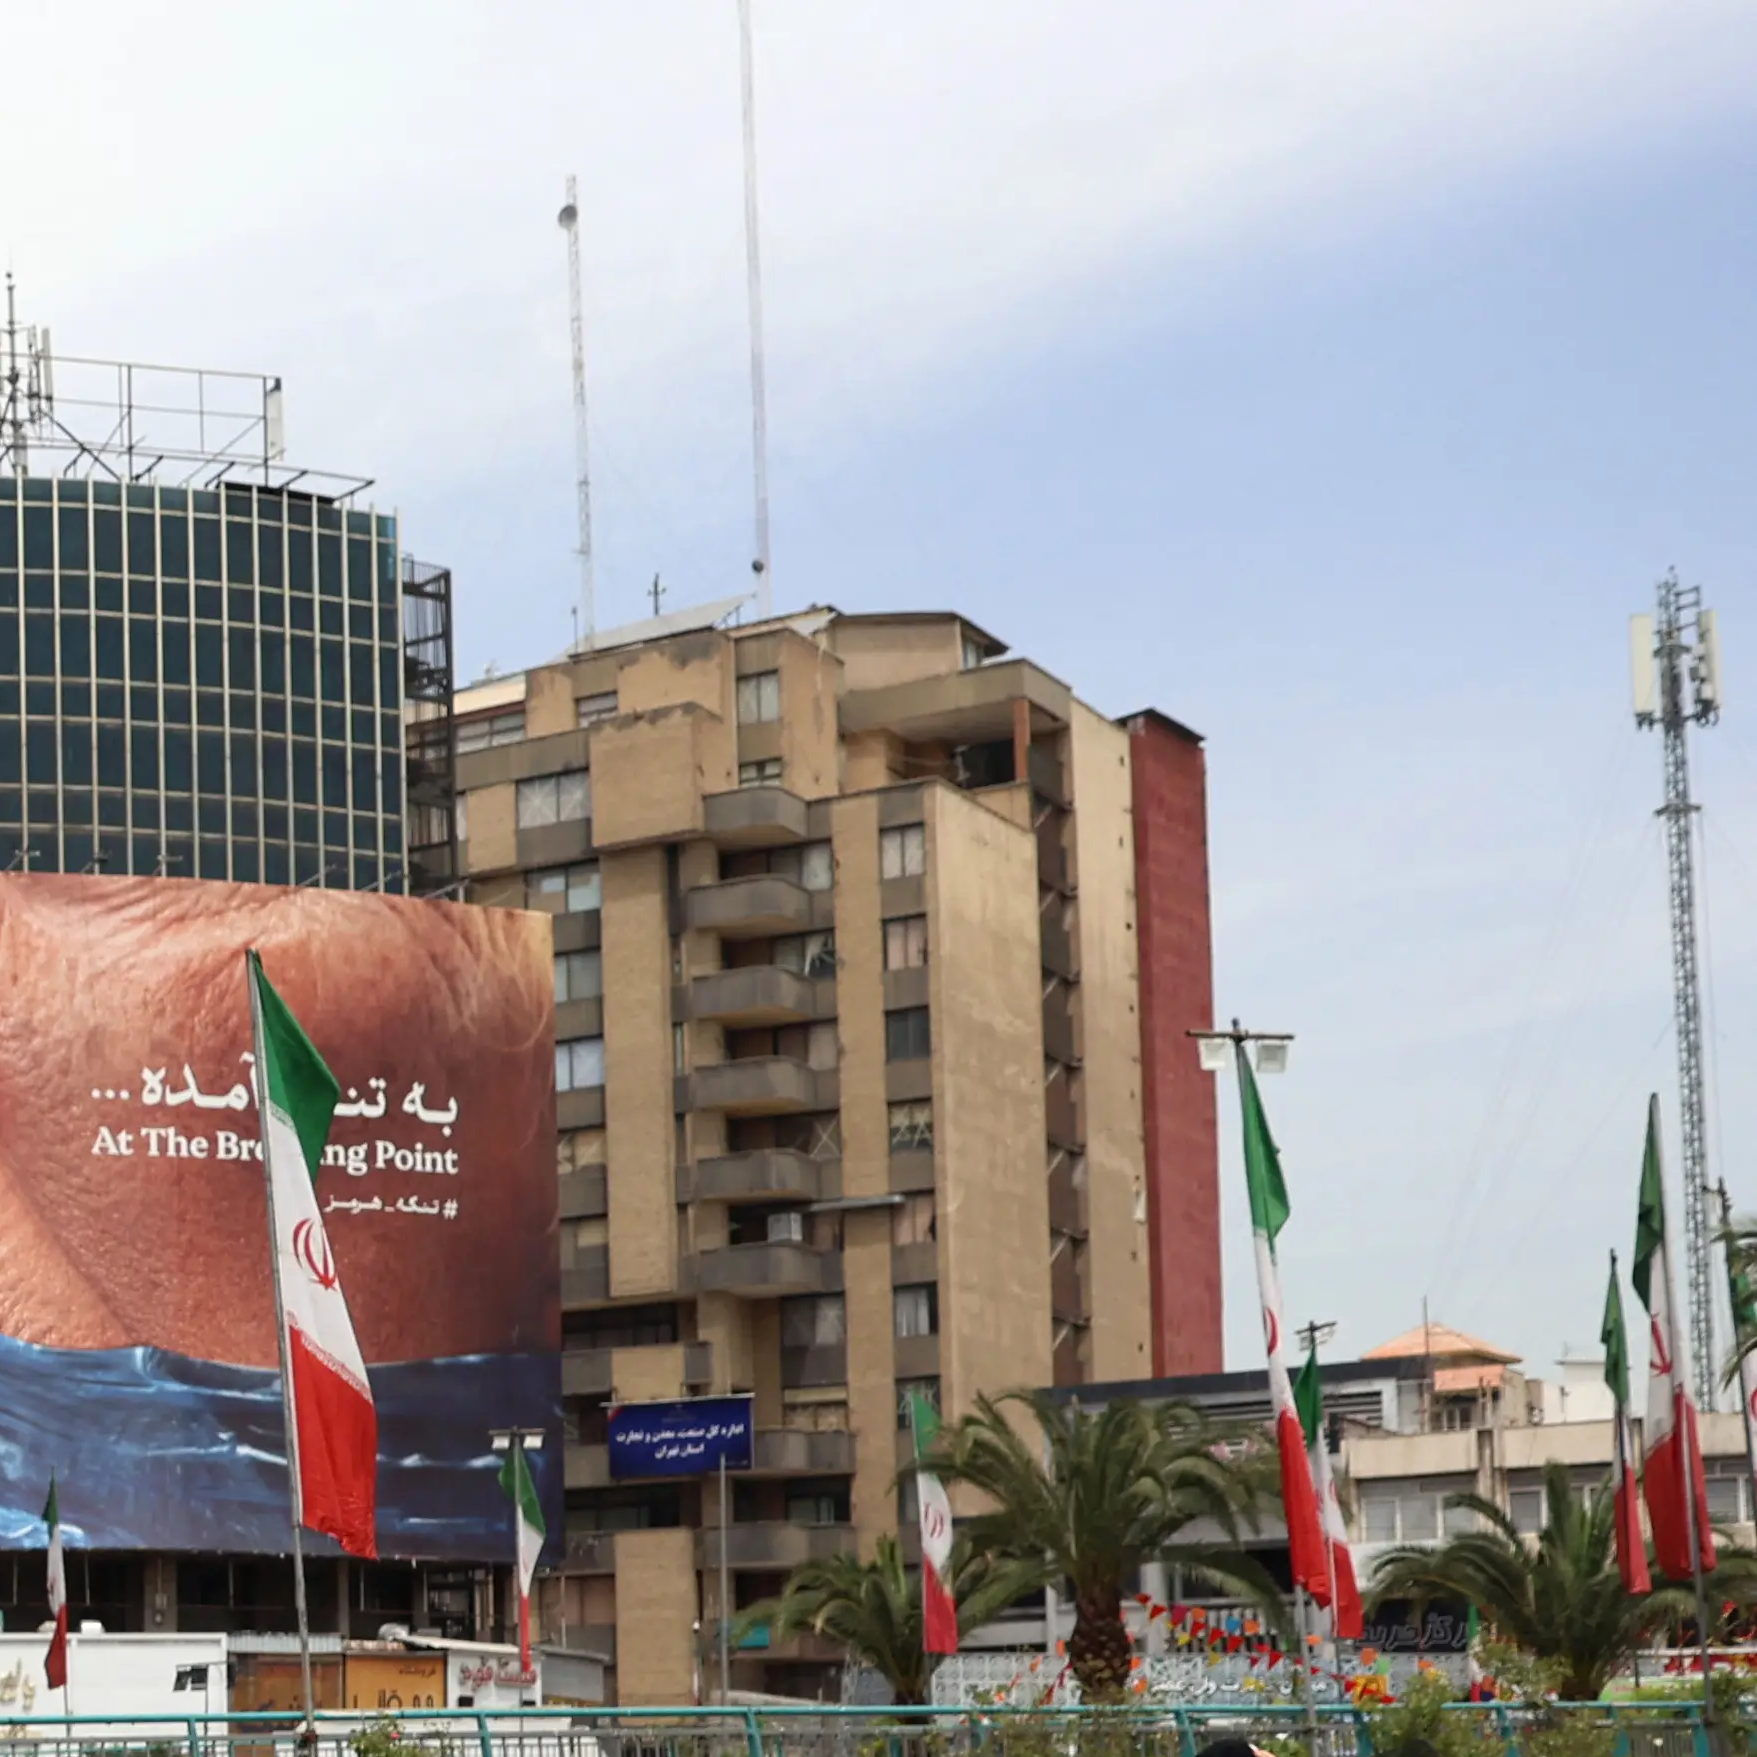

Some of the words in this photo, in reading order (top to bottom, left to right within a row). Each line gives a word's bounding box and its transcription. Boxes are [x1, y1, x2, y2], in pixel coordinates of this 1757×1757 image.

[333, 1076, 387, 1118] تن
[401, 1080, 459, 1138] به
[90, 1126, 135, 1156] At
[139, 1125, 210, 1159] The
[374, 1139, 460, 1176] Point
